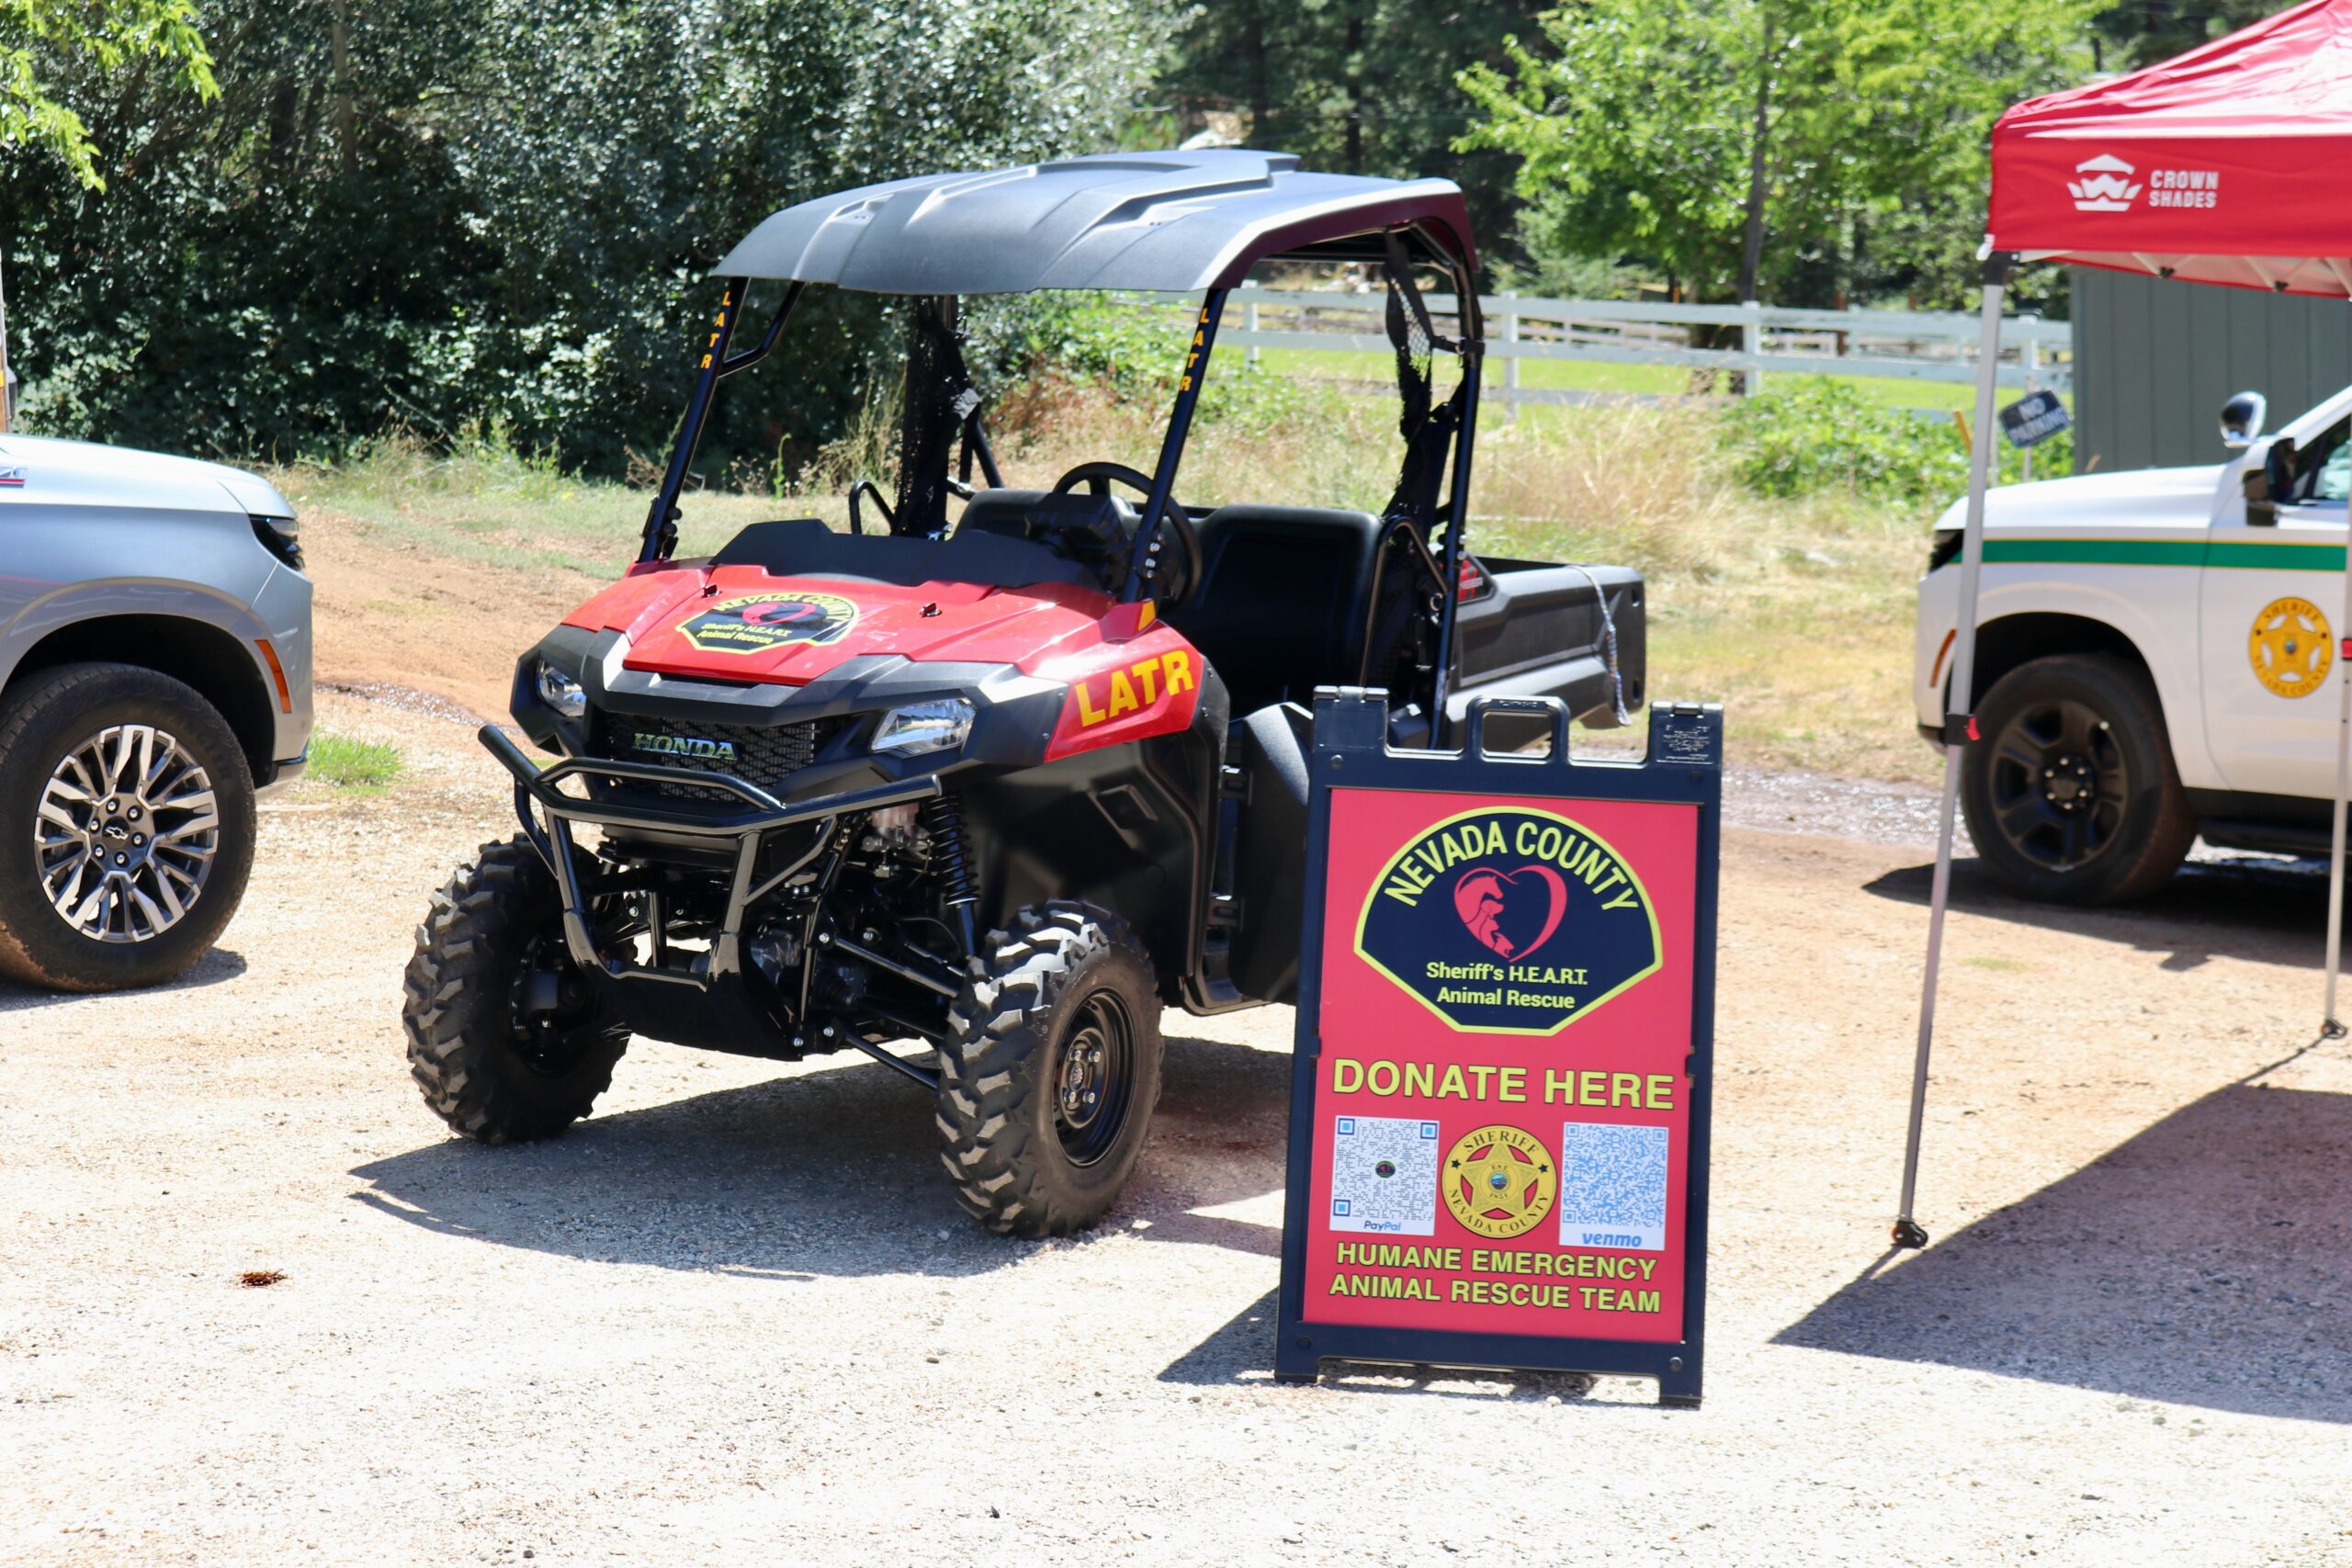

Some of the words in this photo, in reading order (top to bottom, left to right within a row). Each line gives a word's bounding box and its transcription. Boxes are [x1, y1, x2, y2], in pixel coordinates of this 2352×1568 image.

[2150, 169, 2220, 189] CROWN
[2148, 189, 2217, 209] SHADES
[700, 290, 731, 369] LATR
[1179, 307, 1210, 391] LATR
[712, 594, 801, 613] NEVADA
[1074, 649, 1194, 728] LATR
[632, 733, 738, 761] HONDA
[1384, 821, 1509, 907] NEVADA
[1516, 821, 1639, 910] COUNTY
[1426, 962, 1505, 981] Sheriff's
[1509, 965, 1589, 985] H.E.A.R.T.
[1437, 987, 1502, 1005] Animal
[1506, 989, 1576, 1009] Rescue
[1332, 1058, 1528, 1101] DONATE
[1544, 1067, 1674, 1110] HERE
[1464, 1130, 1540, 1154] SHERIFF
[1449, 1189, 1493, 1233] NEVADA
[1498, 1193, 1548, 1234] COUNTY
[1363, 1220, 1401, 1232] PayPal
[1582, 1233, 1643, 1247] venmo
[1336, 1242, 1463, 1270] HUMANE
[1472, 1249, 1657, 1281] EMERGENCY
[1329, 1273, 1442, 1302] ANIMAL
[1451, 1280, 1570, 1308] RESCUE
[1578, 1287, 1661, 1314] TEAM
